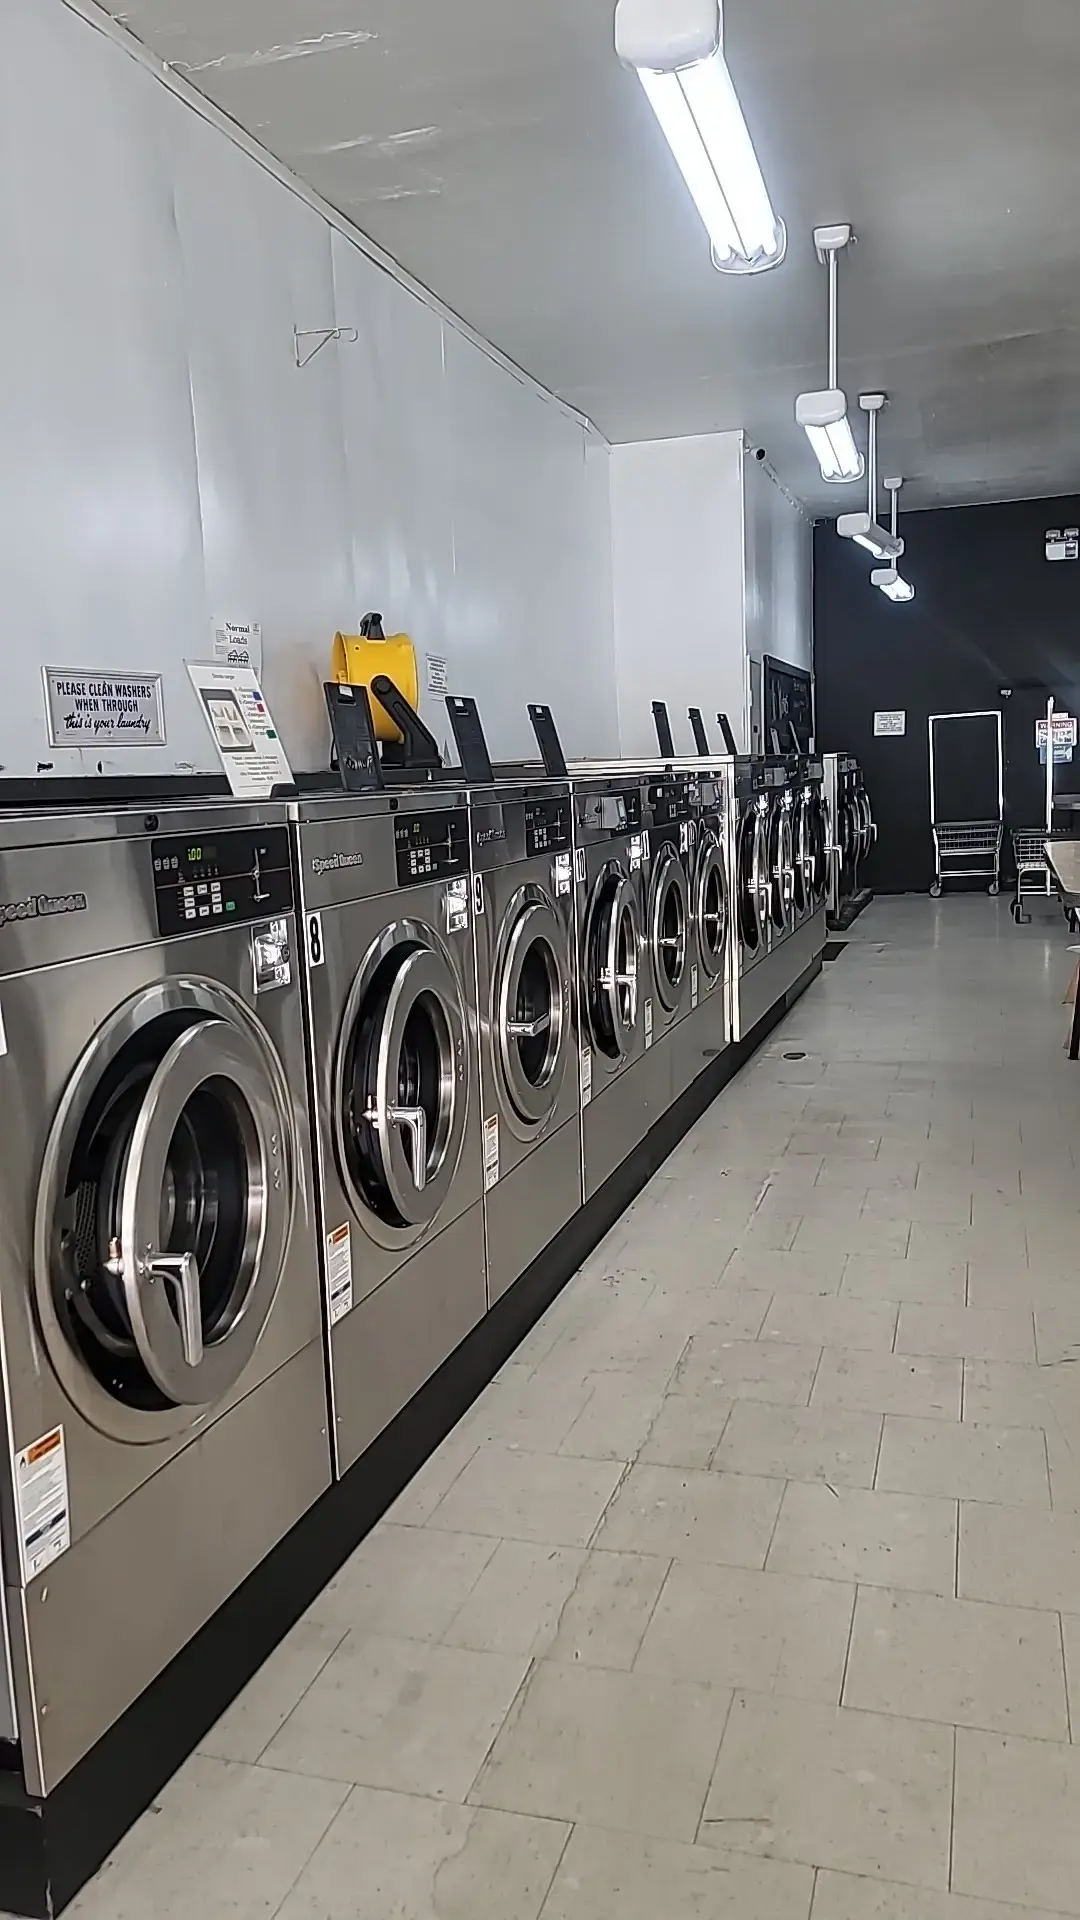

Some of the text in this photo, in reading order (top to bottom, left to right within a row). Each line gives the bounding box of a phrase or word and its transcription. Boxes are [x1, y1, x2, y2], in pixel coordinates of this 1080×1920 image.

[225, 622, 250, 633] Normal
[229, 634, 248, 645] Loads
[57, 682, 151, 699] PLEASE CLEAN WASHERS
[75, 699, 138, 713] WHEN THROUGH
[63, 711, 151, 735] this is your laundry
[312, 853, 339, 876] Speed
[38, 893, 86, 916] Queen
[475, 876, 483, 913] 9
[309, 915, 321, 963] 8
